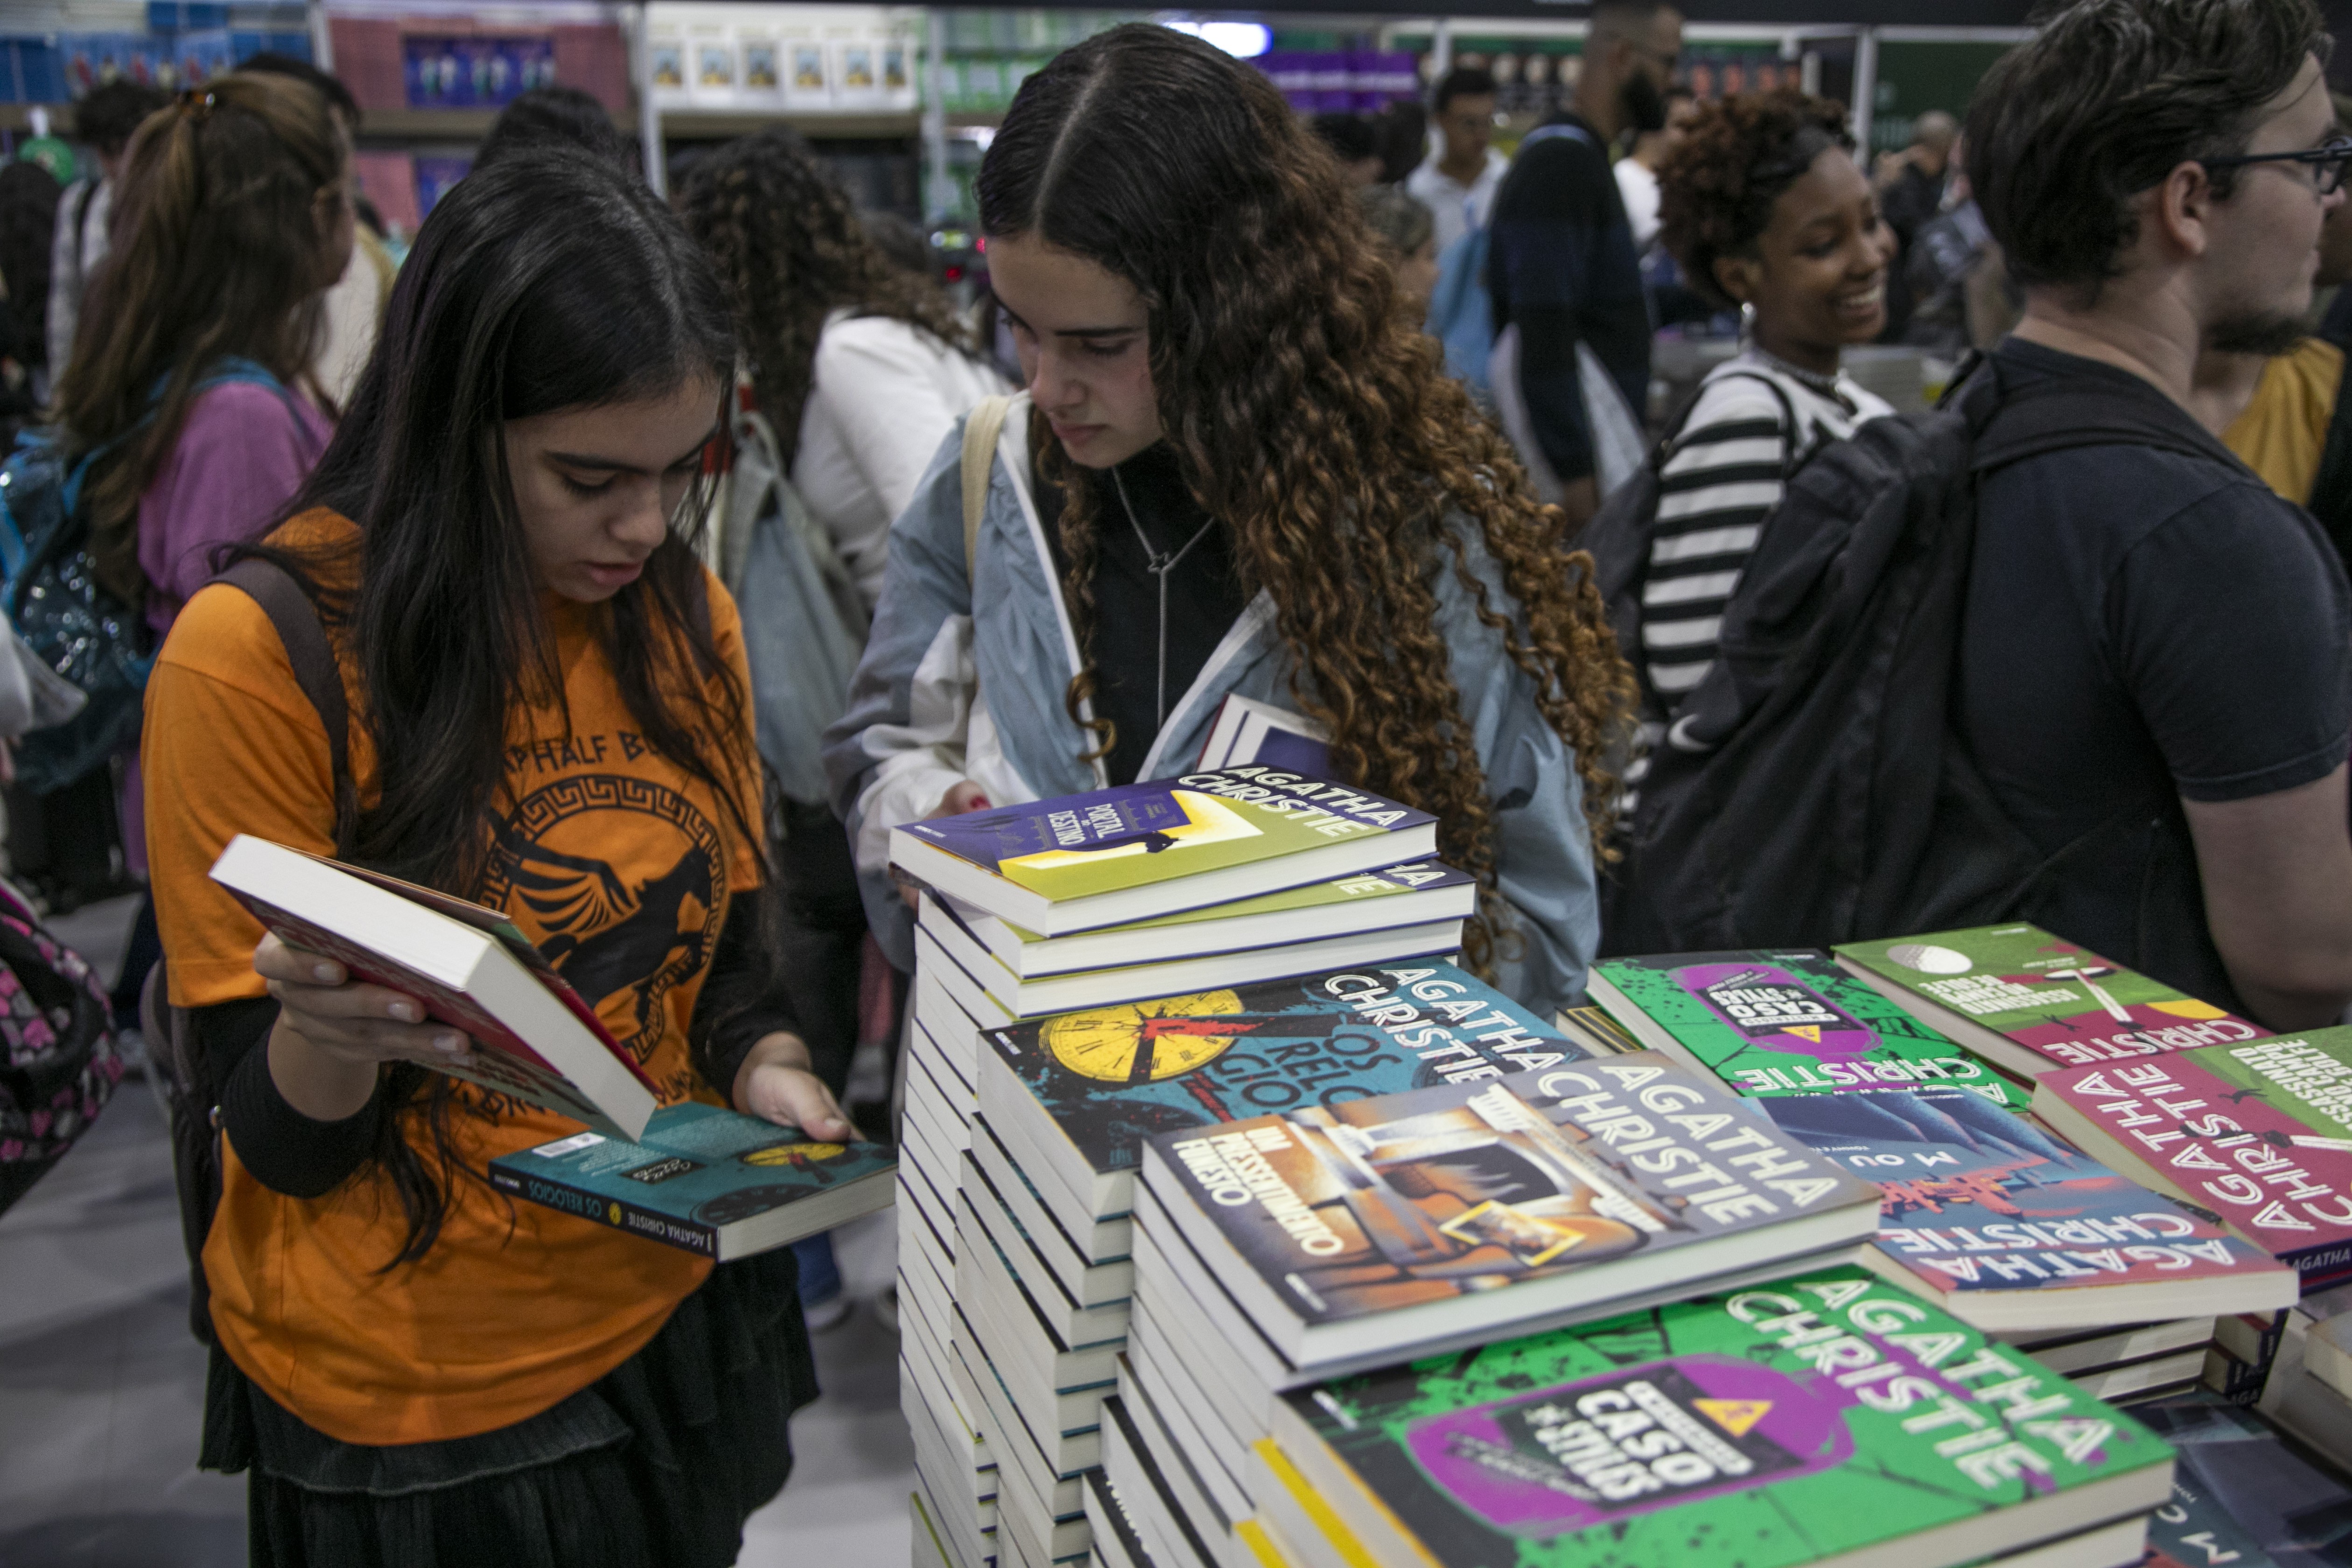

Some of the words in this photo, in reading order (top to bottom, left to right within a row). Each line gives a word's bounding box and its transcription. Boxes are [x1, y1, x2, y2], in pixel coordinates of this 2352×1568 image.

[1178, 774, 1370, 837] CHRISTIE
[1221, 767, 1407, 826] AGATHA
[1047, 810, 1086, 846] DESTINO
[1085, 803, 1126, 839] PORTAL
[1709, 988, 1788, 1006] STYLES
[1726, 1001, 1826, 1018] CASO
[1959, 988, 2080, 1015] ASSASSINATO
[1324, 974, 1504, 1085] CHRISTIE
[1380, 968, 1565, 1072] AGATHA
[1323, 1033, 1402, 1071] OS
[2042, 1020, 2256, 1064] CHRISTIE
[2278, 1039, 2352, 1077] GOLFE
[1214, 1053, 1314, 1115] GIO
[1734, 1057, 1981, 1092] CHRISTIE
[2254, 1043, 2336, 1086] CAMPO
[1245, 1126, 1293, 1152] UM
[1538, 1071, 1779, 1225] CHRISTIE
[1598, 1065, 1839, 1207] AGATHA
[2072, 1071, 2316, 1231] AGATHA
[2112, 1064, 2352, 1225] CHRISTIE
[1172, 1139, 1253, 1206] FUNESTO
[1848, 1154, 1905, 1167] OU
[1912, 1151, 1962, 1167] M
[585, 1198, 602, 1218] OS
[1209, 1130, 1344, 1256] PRESSENTIMENTO
[628, 1212, 665, 1236] CHRISTIE
[667, 1224, 705, 1246] AGATHA
[1878, 1212, 2194, 1253] CHRISTIE
[1919, 1239, 2236, 1282] AGATHA
[1726, 1291, 2054, 1489] CHRISTIE
[1792, 1280, 2115, 1464] AGATHA
[1576, 1389, 1717, 1485] CASO
